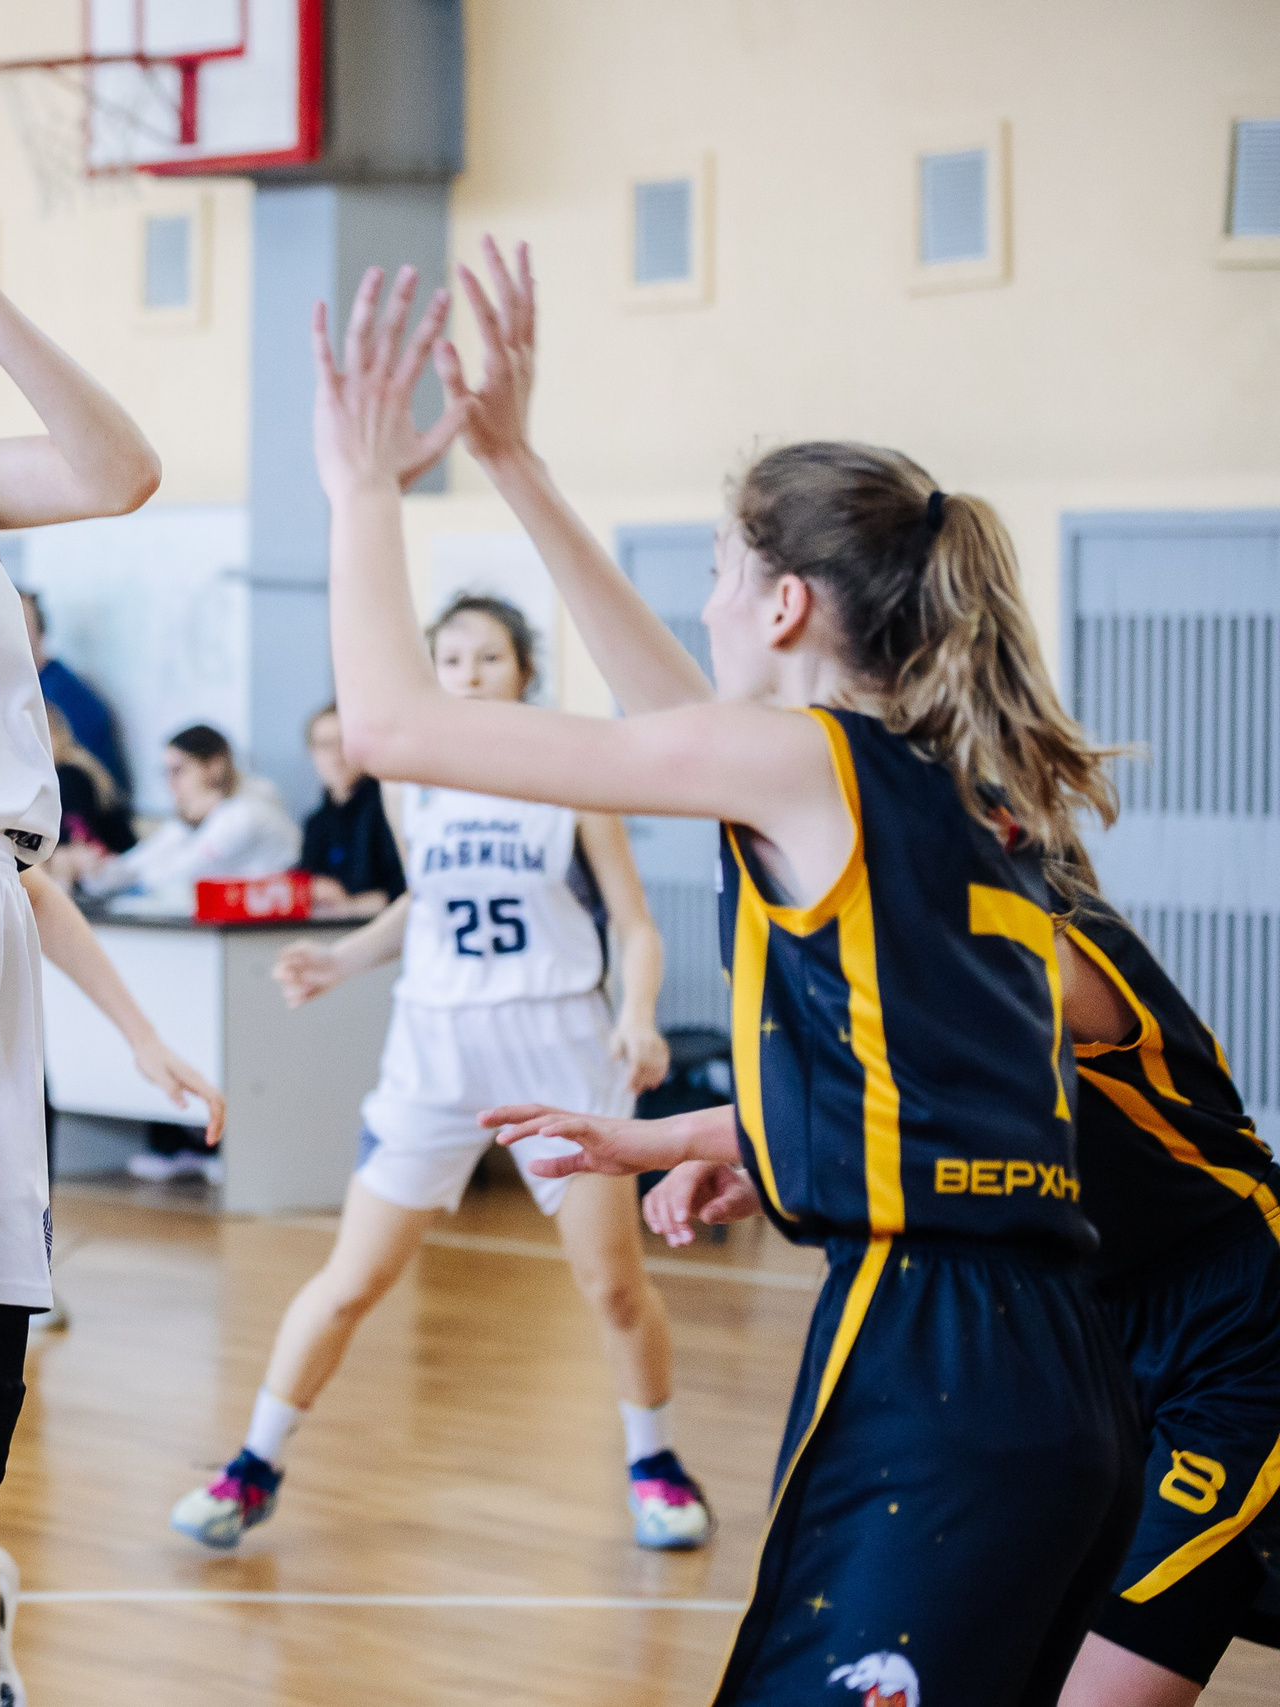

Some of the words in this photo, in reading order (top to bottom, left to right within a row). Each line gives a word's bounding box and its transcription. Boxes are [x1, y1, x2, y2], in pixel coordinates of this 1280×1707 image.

[447, 898, 527, 956] 25
[968, 882, 1072, 1122] 7
[1158, 1449, 1227, 1515] 8
